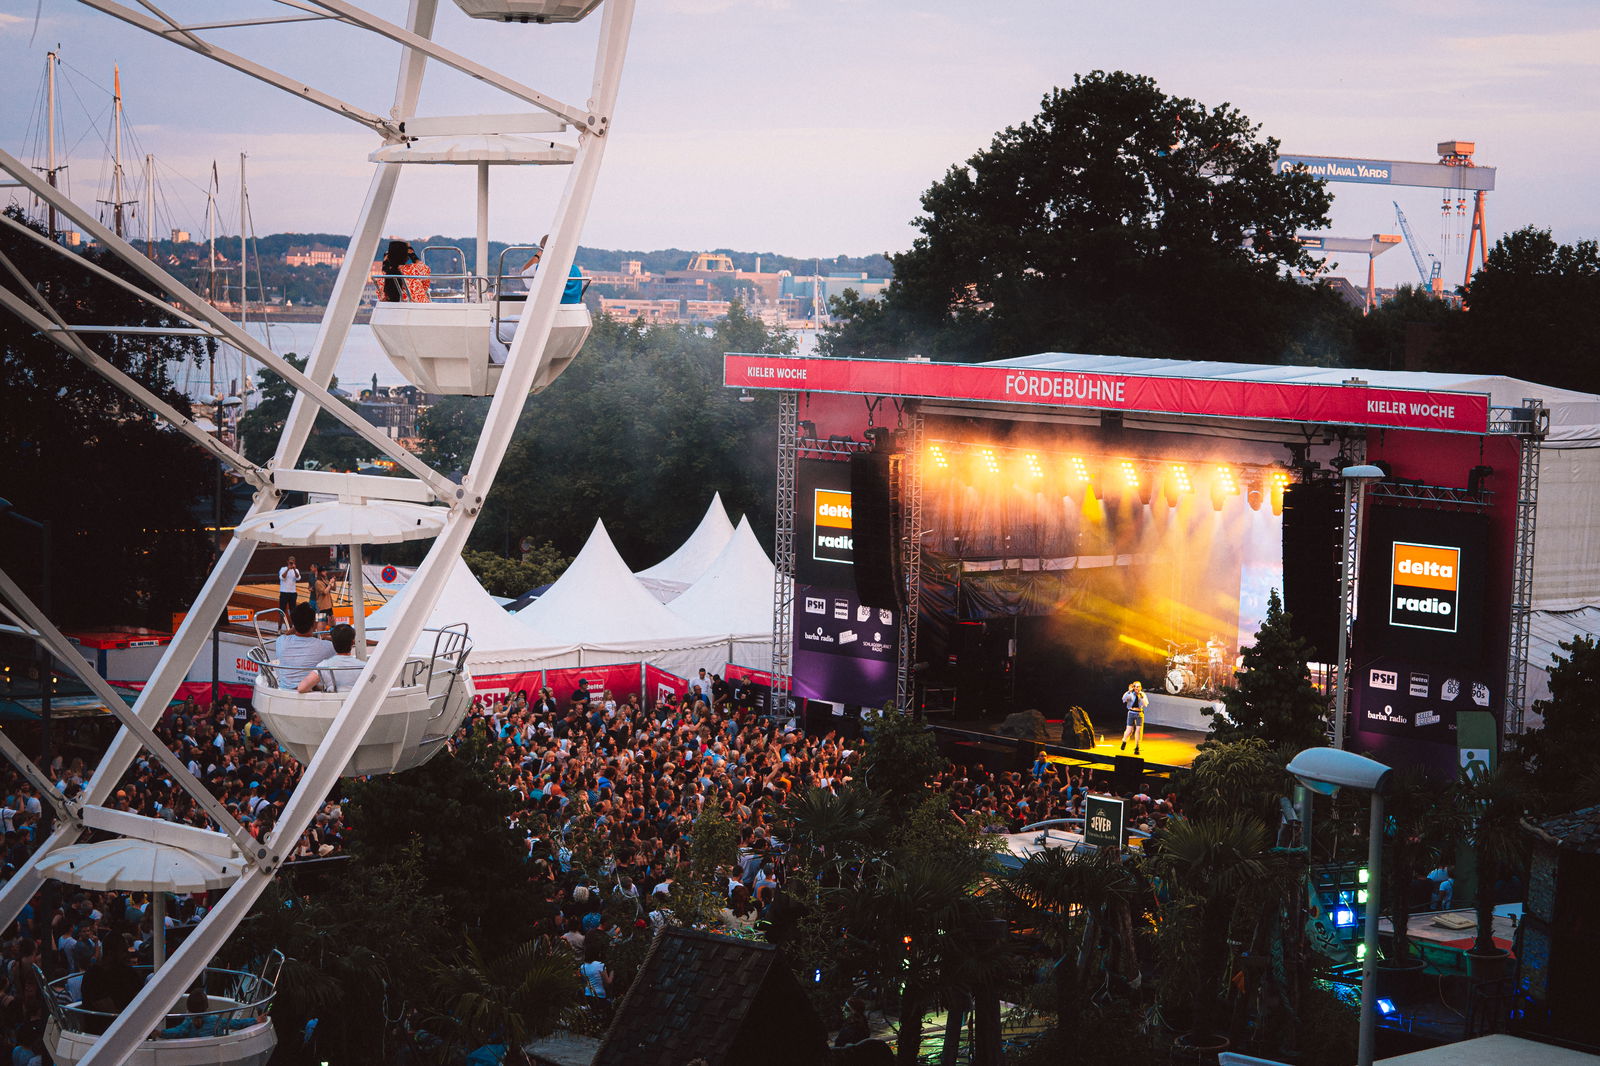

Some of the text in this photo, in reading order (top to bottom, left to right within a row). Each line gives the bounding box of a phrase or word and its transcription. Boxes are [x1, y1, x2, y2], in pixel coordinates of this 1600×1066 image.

[1327, 163, 1357, 177] NAVAL
[1357, 165, 1388, 179] YARDS
[747, 366, 807, 380] KIELER WOCHE
[1005, 371, 1125, 402] FÖRDEBÜHNE
[1367, 400, 1455, 419] KIELER WOCHE
[818, 504, 852, 518] delt
[1398, 559, 1453, 578] delta
[807, 600, 824, 609] RSH
[1396, 597, 1452, 615] radio
[1372, 672, 1395, 685] RSH
[1367, 710, 1407, 724] barba radio
[1090, 816, 1112, 832] JEVER
